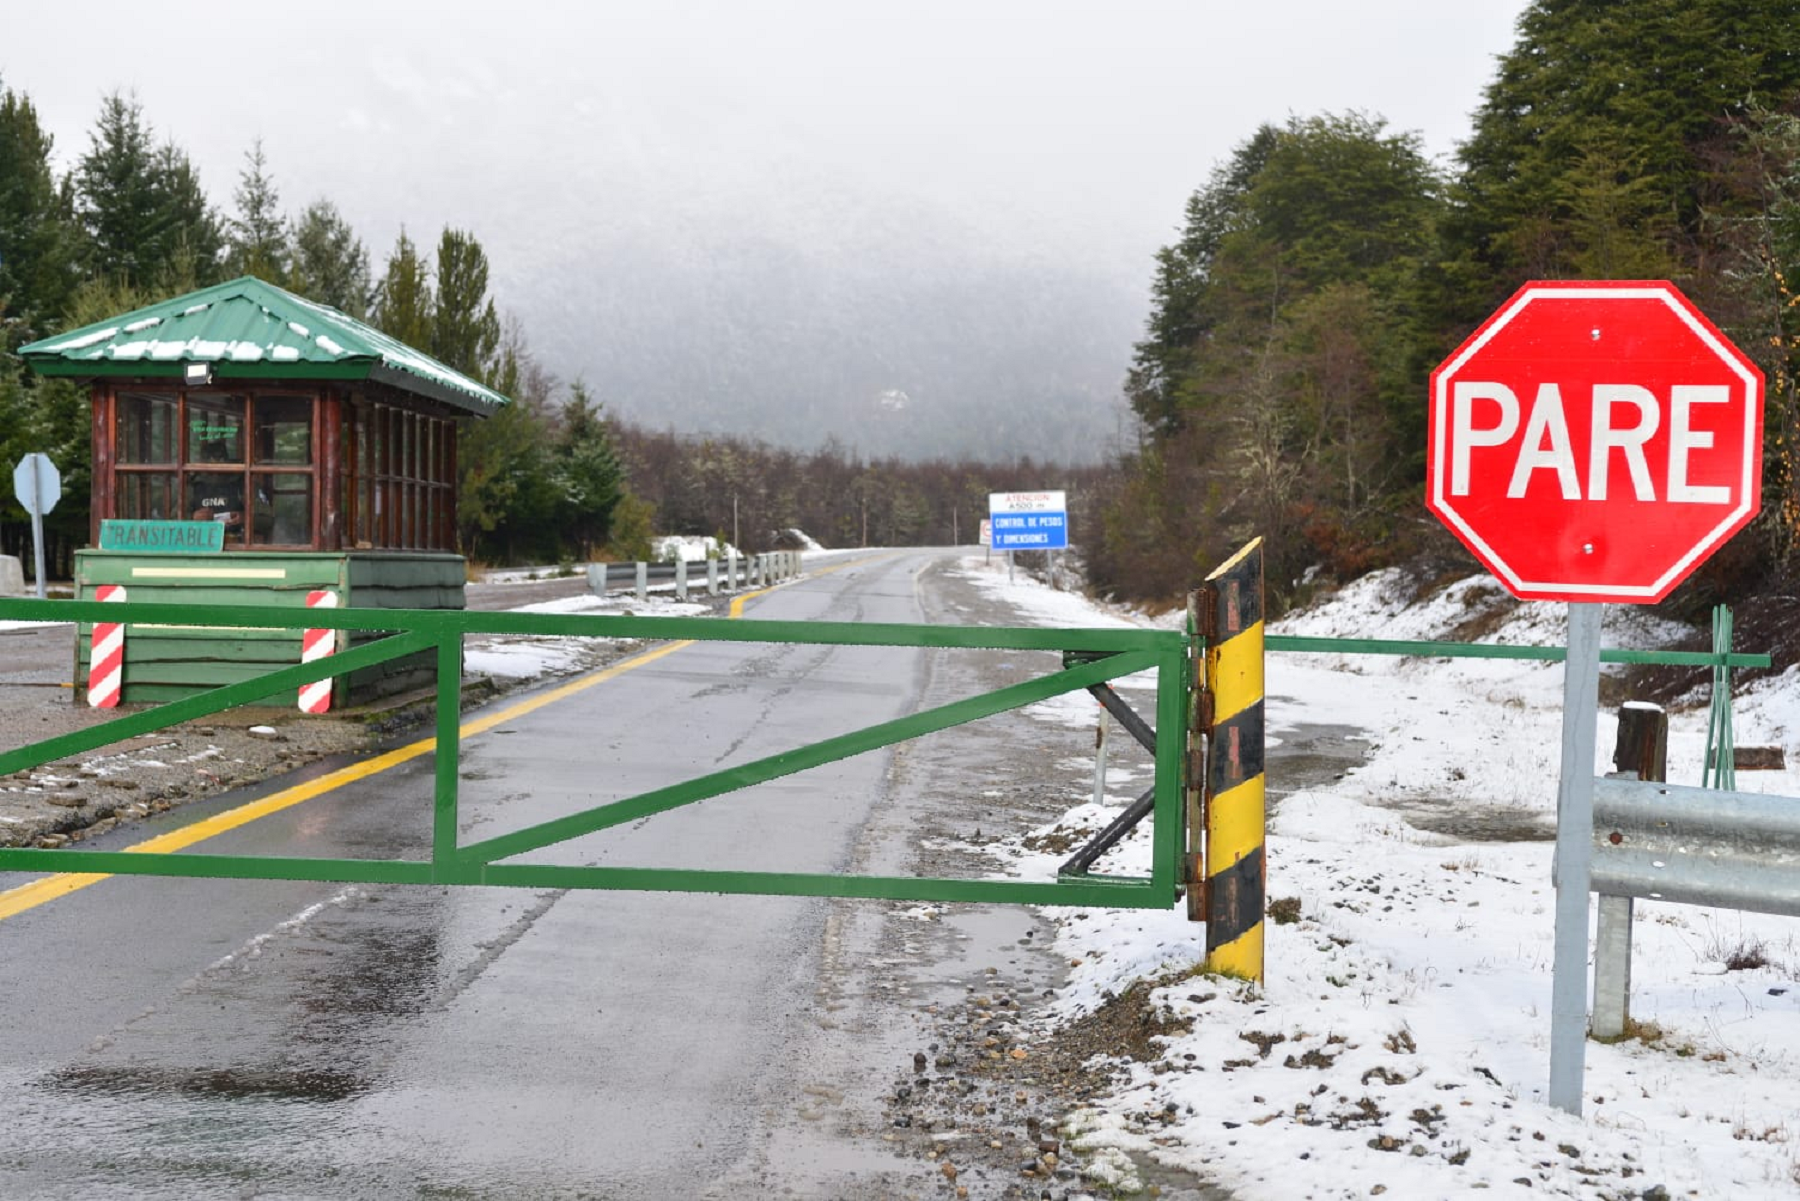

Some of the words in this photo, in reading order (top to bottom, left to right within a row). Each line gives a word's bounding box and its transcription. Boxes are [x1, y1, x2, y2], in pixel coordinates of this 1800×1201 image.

[1451, 381, 1731, 504] PARE
[202, 498, 225, 507] GNA
[995, 517, 1026, 529] CONTROL
[1027, 517, 1037, 527] DE
[1039, 516, 1063, 527] PESOS
[107, 525, 218, 548] TRANSITABLE
[995, 535, 1002, 544] Y
[1003, 533, 1048, 544] DIMENSIONES
